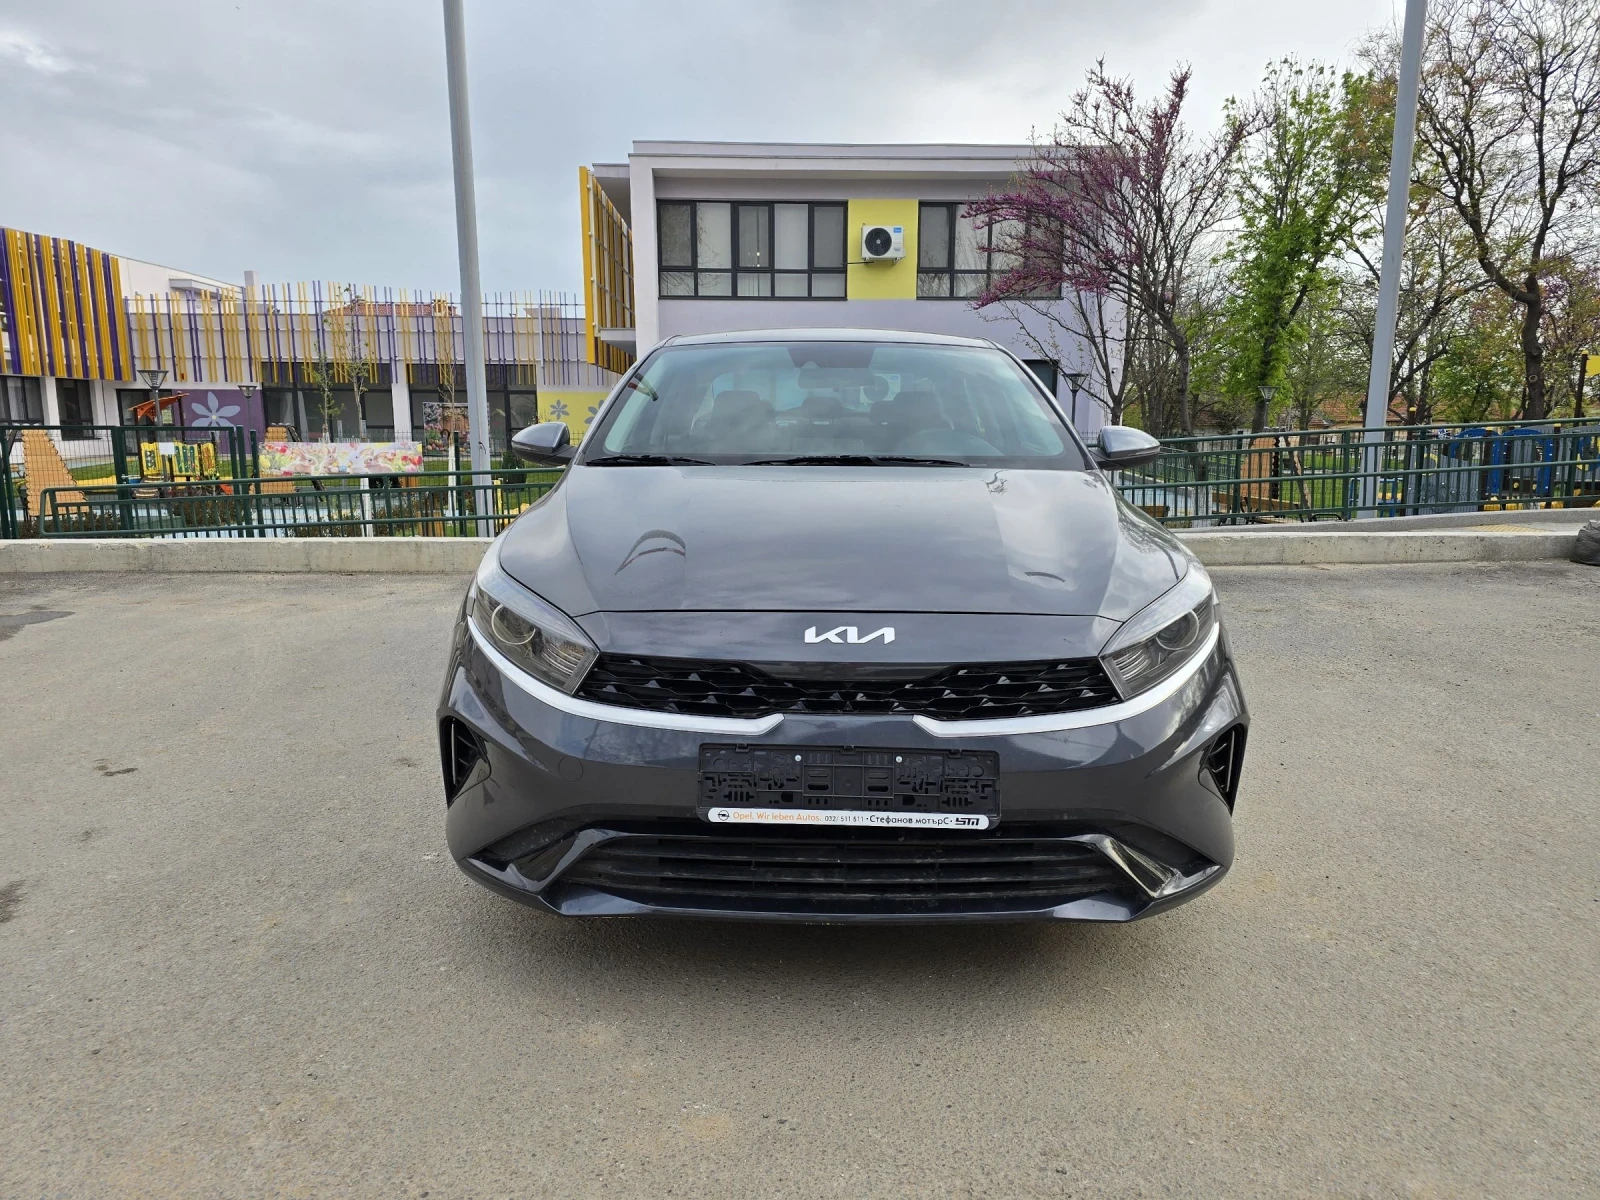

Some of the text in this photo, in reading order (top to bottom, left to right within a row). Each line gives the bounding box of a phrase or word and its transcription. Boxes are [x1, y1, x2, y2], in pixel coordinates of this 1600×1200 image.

[804, 626, 895, 645] KIA
[733, 811, 754, 821] Opel.
[757, 812, 770, 820] Wir
[771, 811, 794, 821] leben
[796, 813, 822, 821] Autos.
[869, 815, 913, 824] Стефанов
